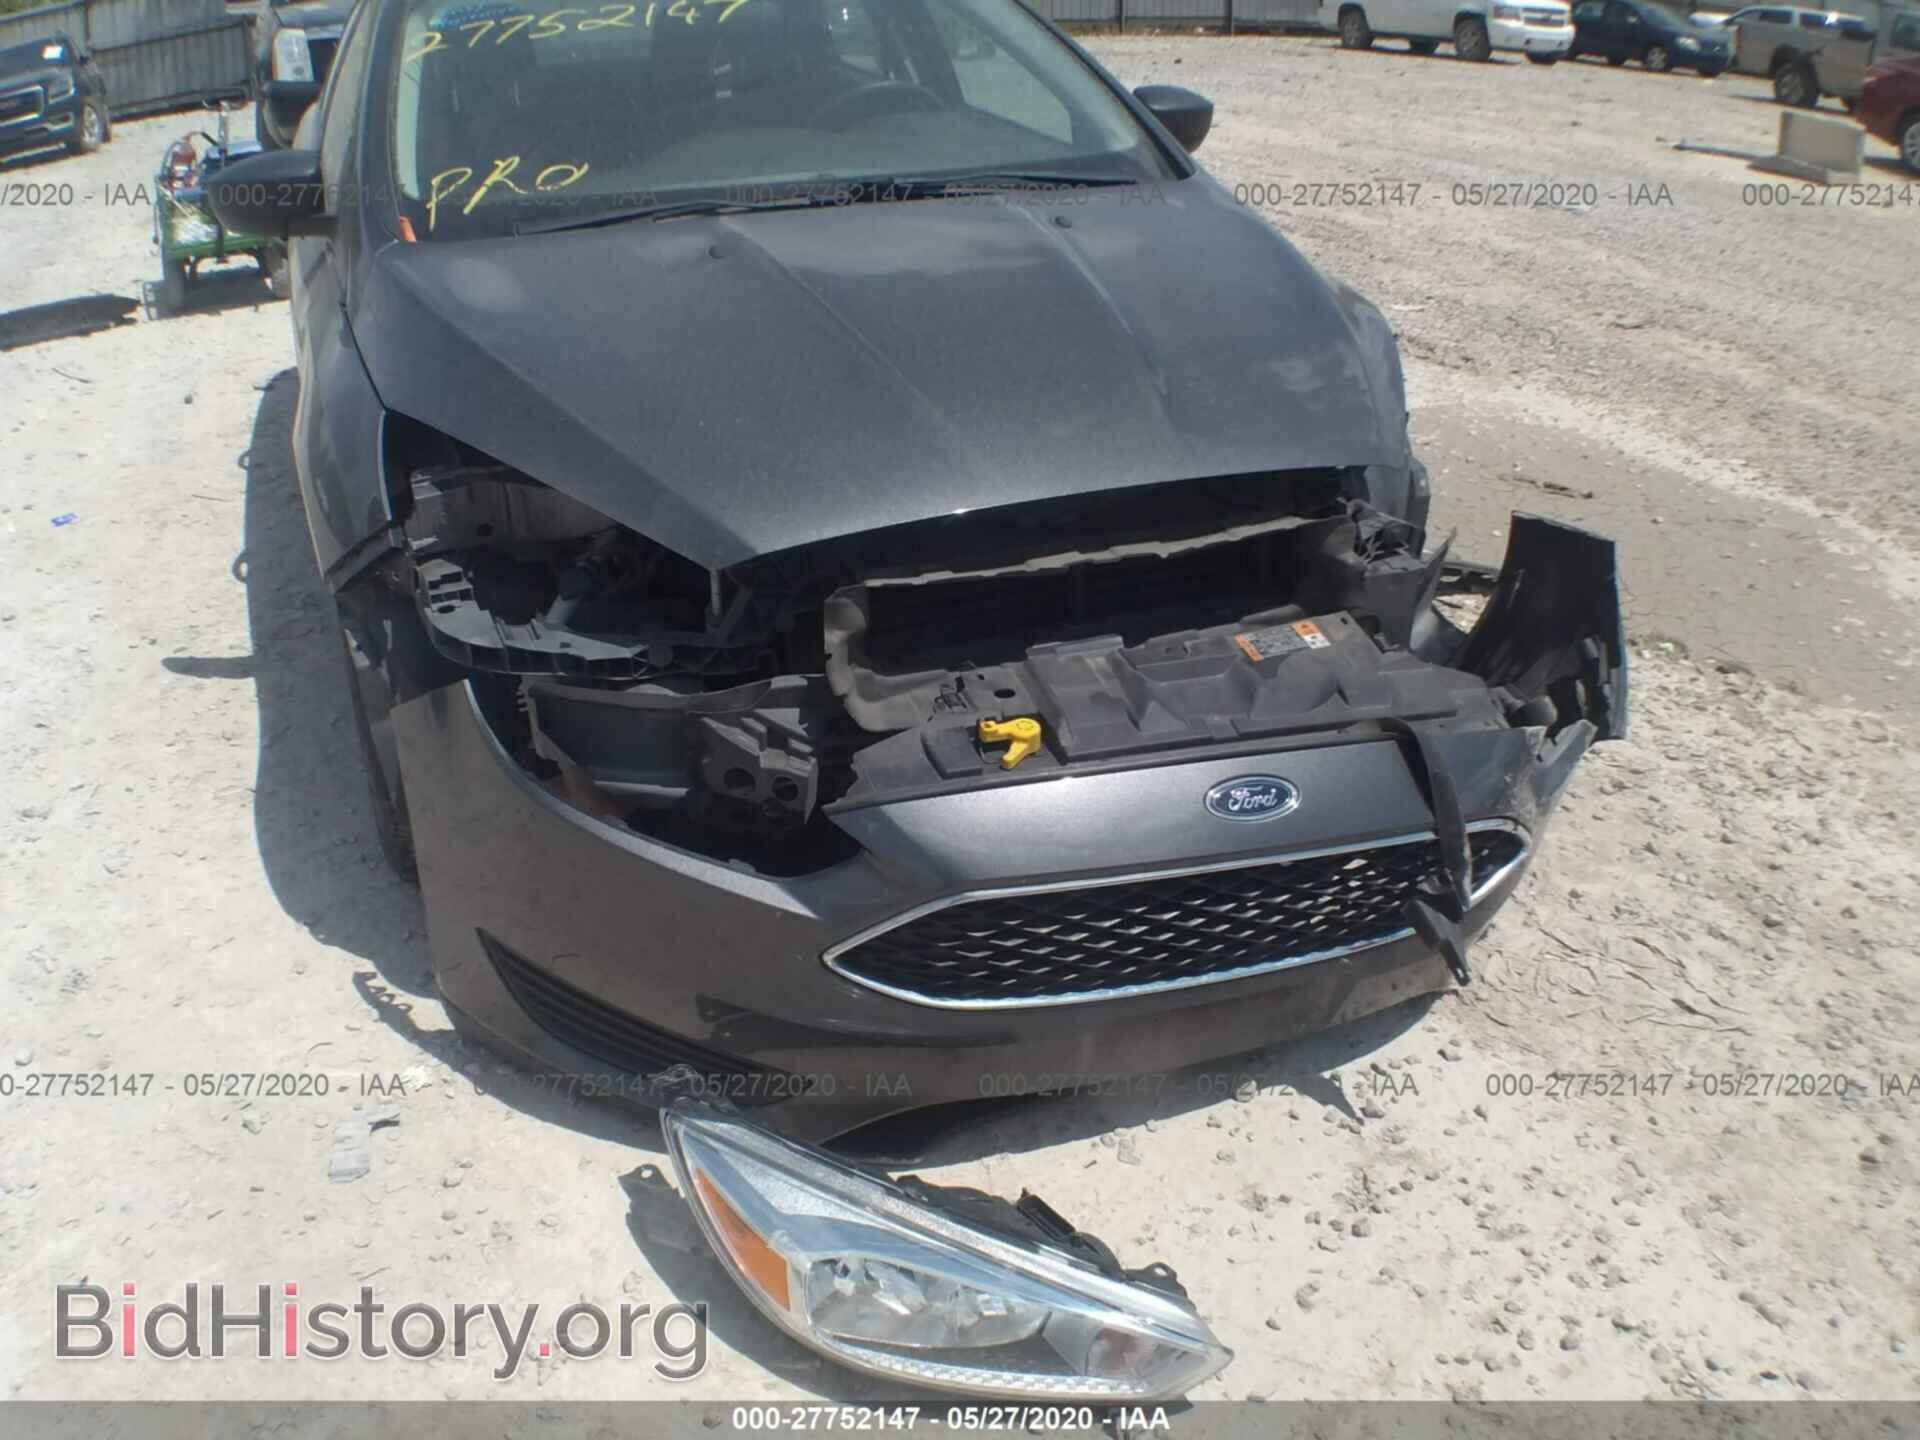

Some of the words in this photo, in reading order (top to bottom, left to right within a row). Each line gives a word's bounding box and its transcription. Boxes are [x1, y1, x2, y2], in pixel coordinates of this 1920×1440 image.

[402, 0, 748, 64] 27752147
[426, 155, 590, 232] PRO
[1228, 785, 1278, 811] Ford
